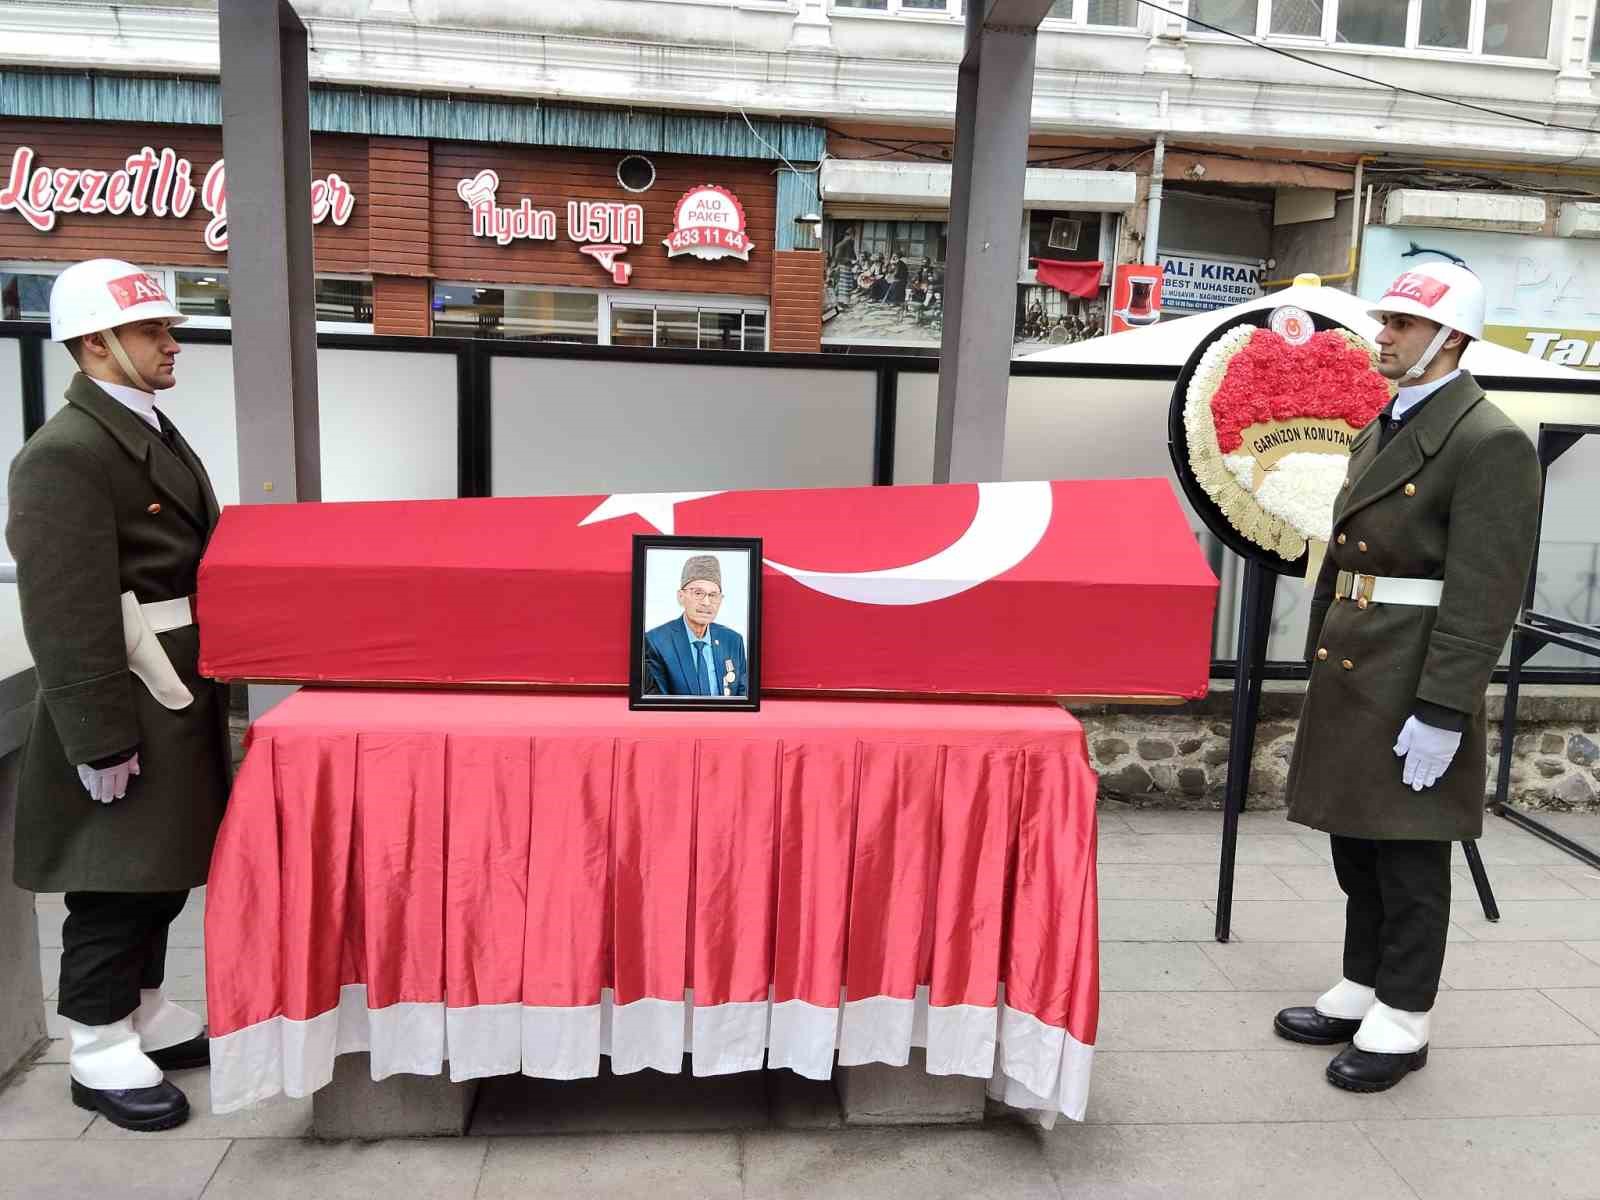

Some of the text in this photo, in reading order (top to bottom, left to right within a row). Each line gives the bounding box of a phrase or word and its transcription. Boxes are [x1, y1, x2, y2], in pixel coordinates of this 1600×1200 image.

[0, 146, 196, 231] Lezzetli
[697, 200, 721, 210] ALO
[567, 201, 643, 245] USTA
[688, 211, 729, 223] PAKET
[673, 228, 743, 248] 433 11 44
[1201, 263, 1265, 283] KIRAN
[1253, 428, 1301, 453] GARNİZON
